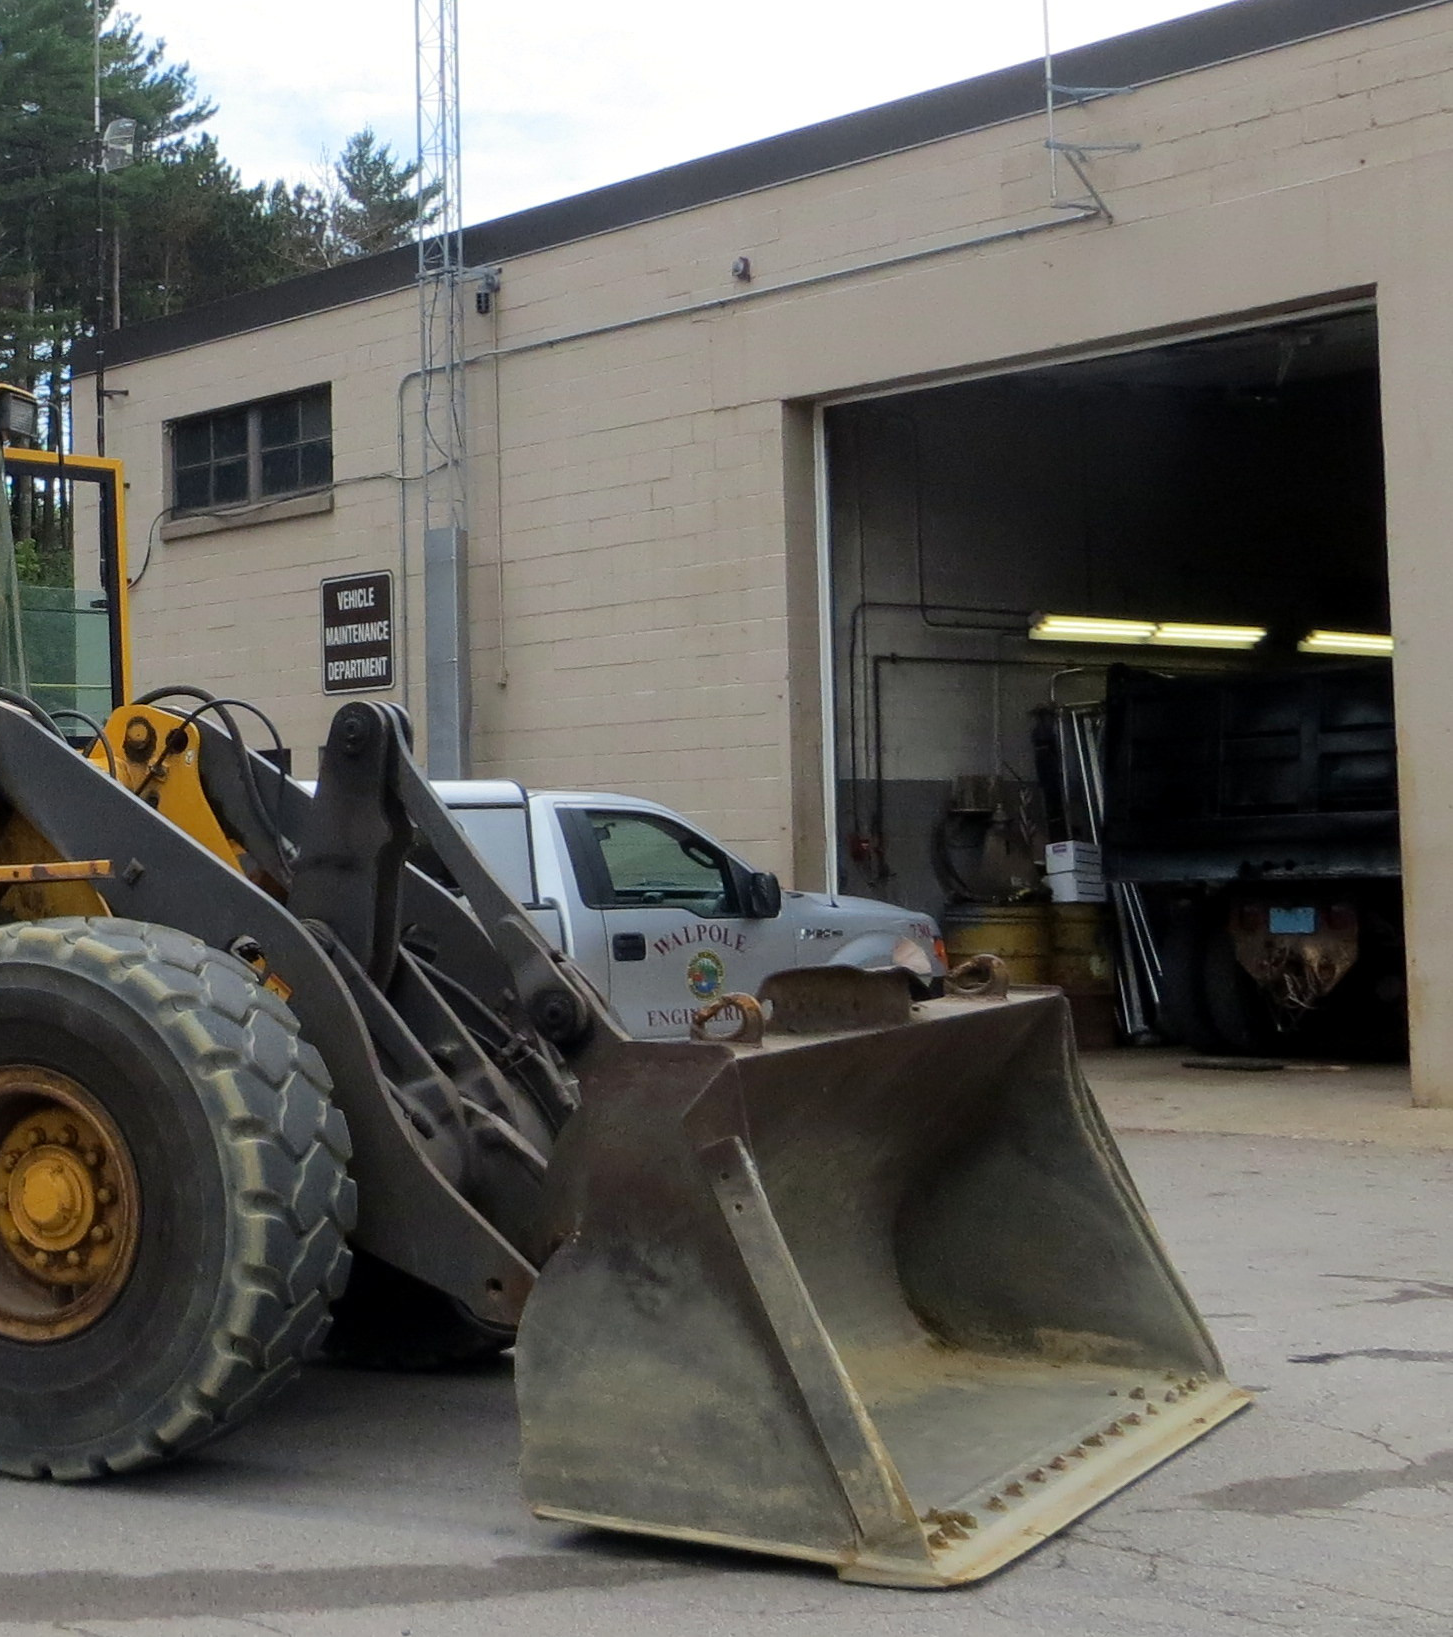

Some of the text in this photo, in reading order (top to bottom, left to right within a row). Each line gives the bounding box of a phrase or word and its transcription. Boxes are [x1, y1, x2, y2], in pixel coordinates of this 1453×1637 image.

[336, 586, 375, 611] VEHICLE
[325, 620, 390, 647] MAINTENANCE
[327, 656, 388, 681] DEPARTMENT
[652, 923, 750, 957] WALPOLE
